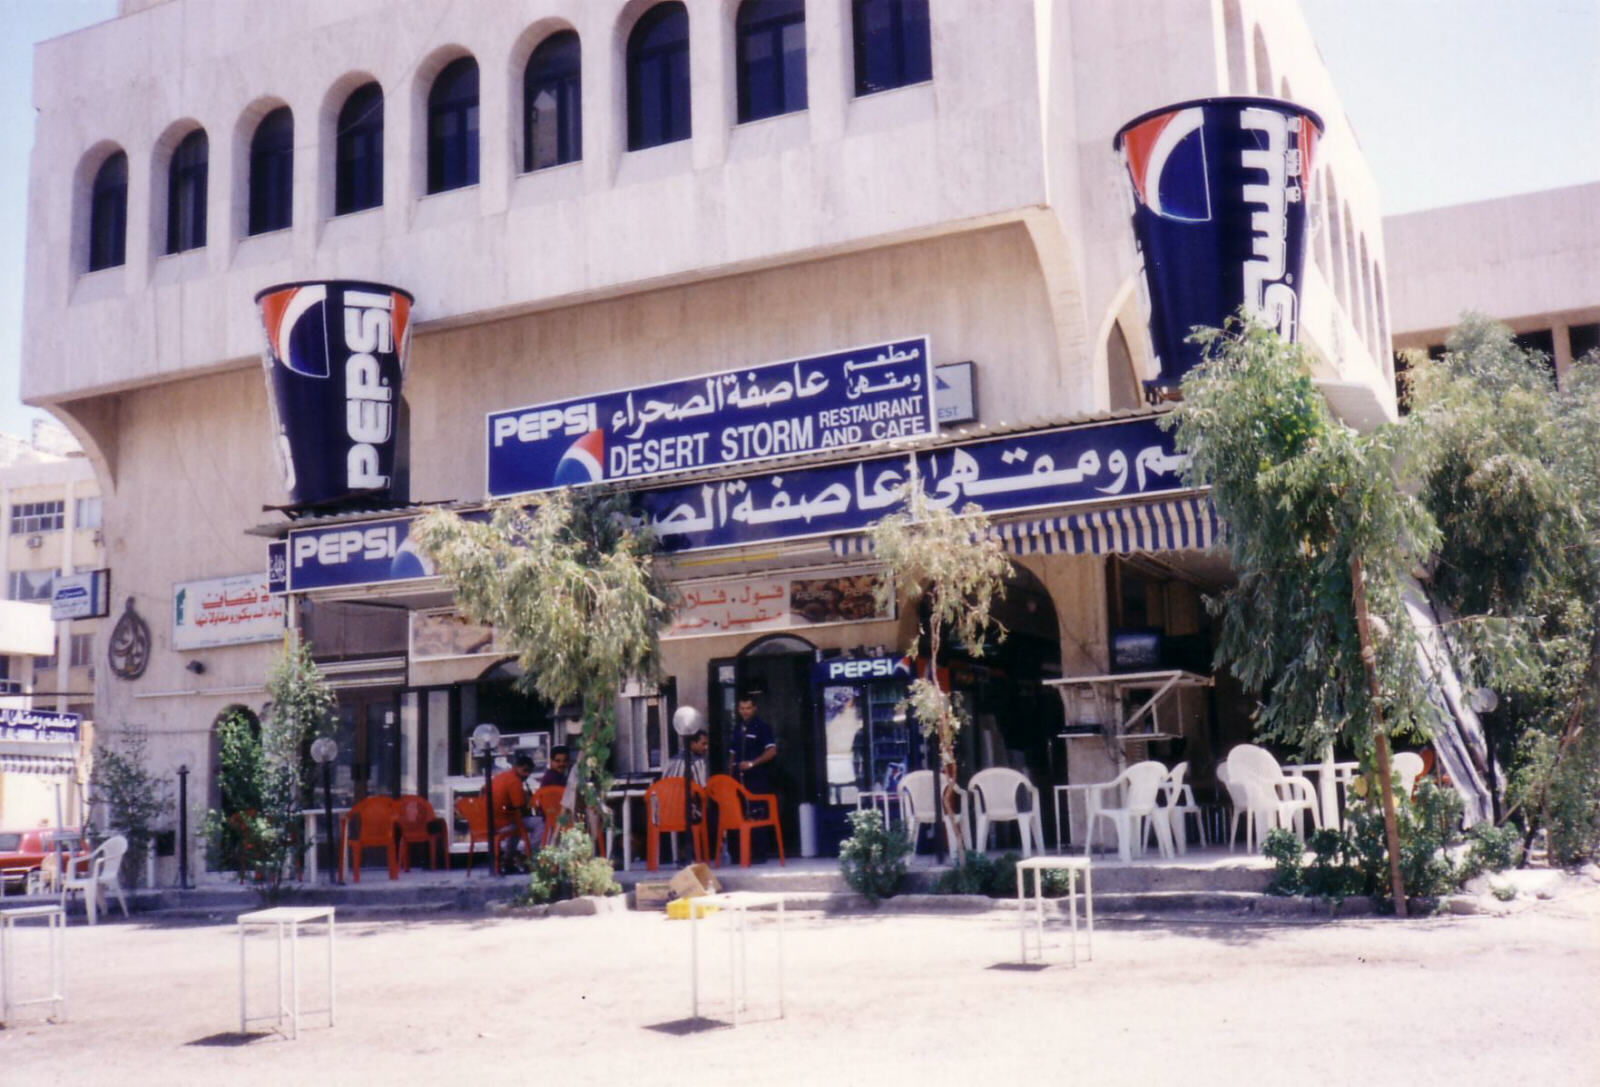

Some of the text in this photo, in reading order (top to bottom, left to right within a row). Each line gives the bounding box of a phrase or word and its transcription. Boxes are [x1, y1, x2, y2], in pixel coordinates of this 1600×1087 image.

[843, 344, 920, 378] مطعم
[344, 290, 393, 489] PEPSI
[611, 362, 830, 440] عاصفة الصحراء
[494, 402, 598, 447] PEPSI
[819, 394, 923, 429] RESTAURANT
[821, 416, 925, 448] AND CAFE
[610, 416, 814, 478] DESERT STORM
[726, 462, 905, 525] عاصفة
[294, 526, 398, 568] PEPSI
[829, 658, 893, 679] PEPSI
